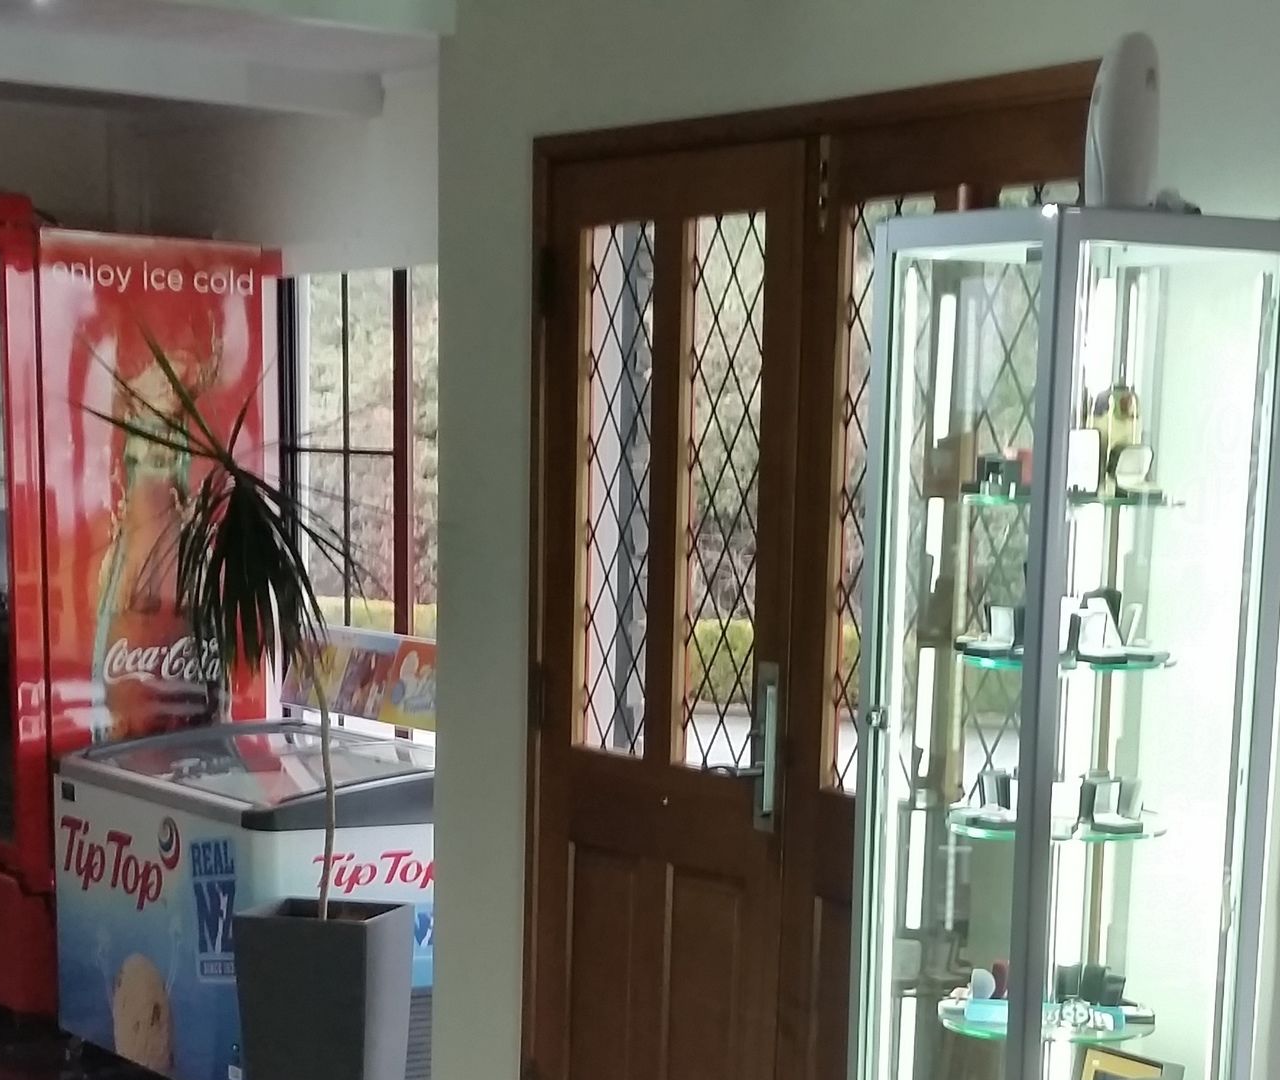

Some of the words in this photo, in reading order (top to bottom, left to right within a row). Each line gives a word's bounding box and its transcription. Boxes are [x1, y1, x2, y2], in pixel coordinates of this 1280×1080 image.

[52, 257, 132, 293] enjoy
[143, 261, 184, 292] ice
[193, 268, 254, 296] cold
[60, 815, 106, 891] Tip
[106, 830, 163, 911] Top
[191, 839, 235, 877] REAL
[312, 853, 378, 894] Tip
